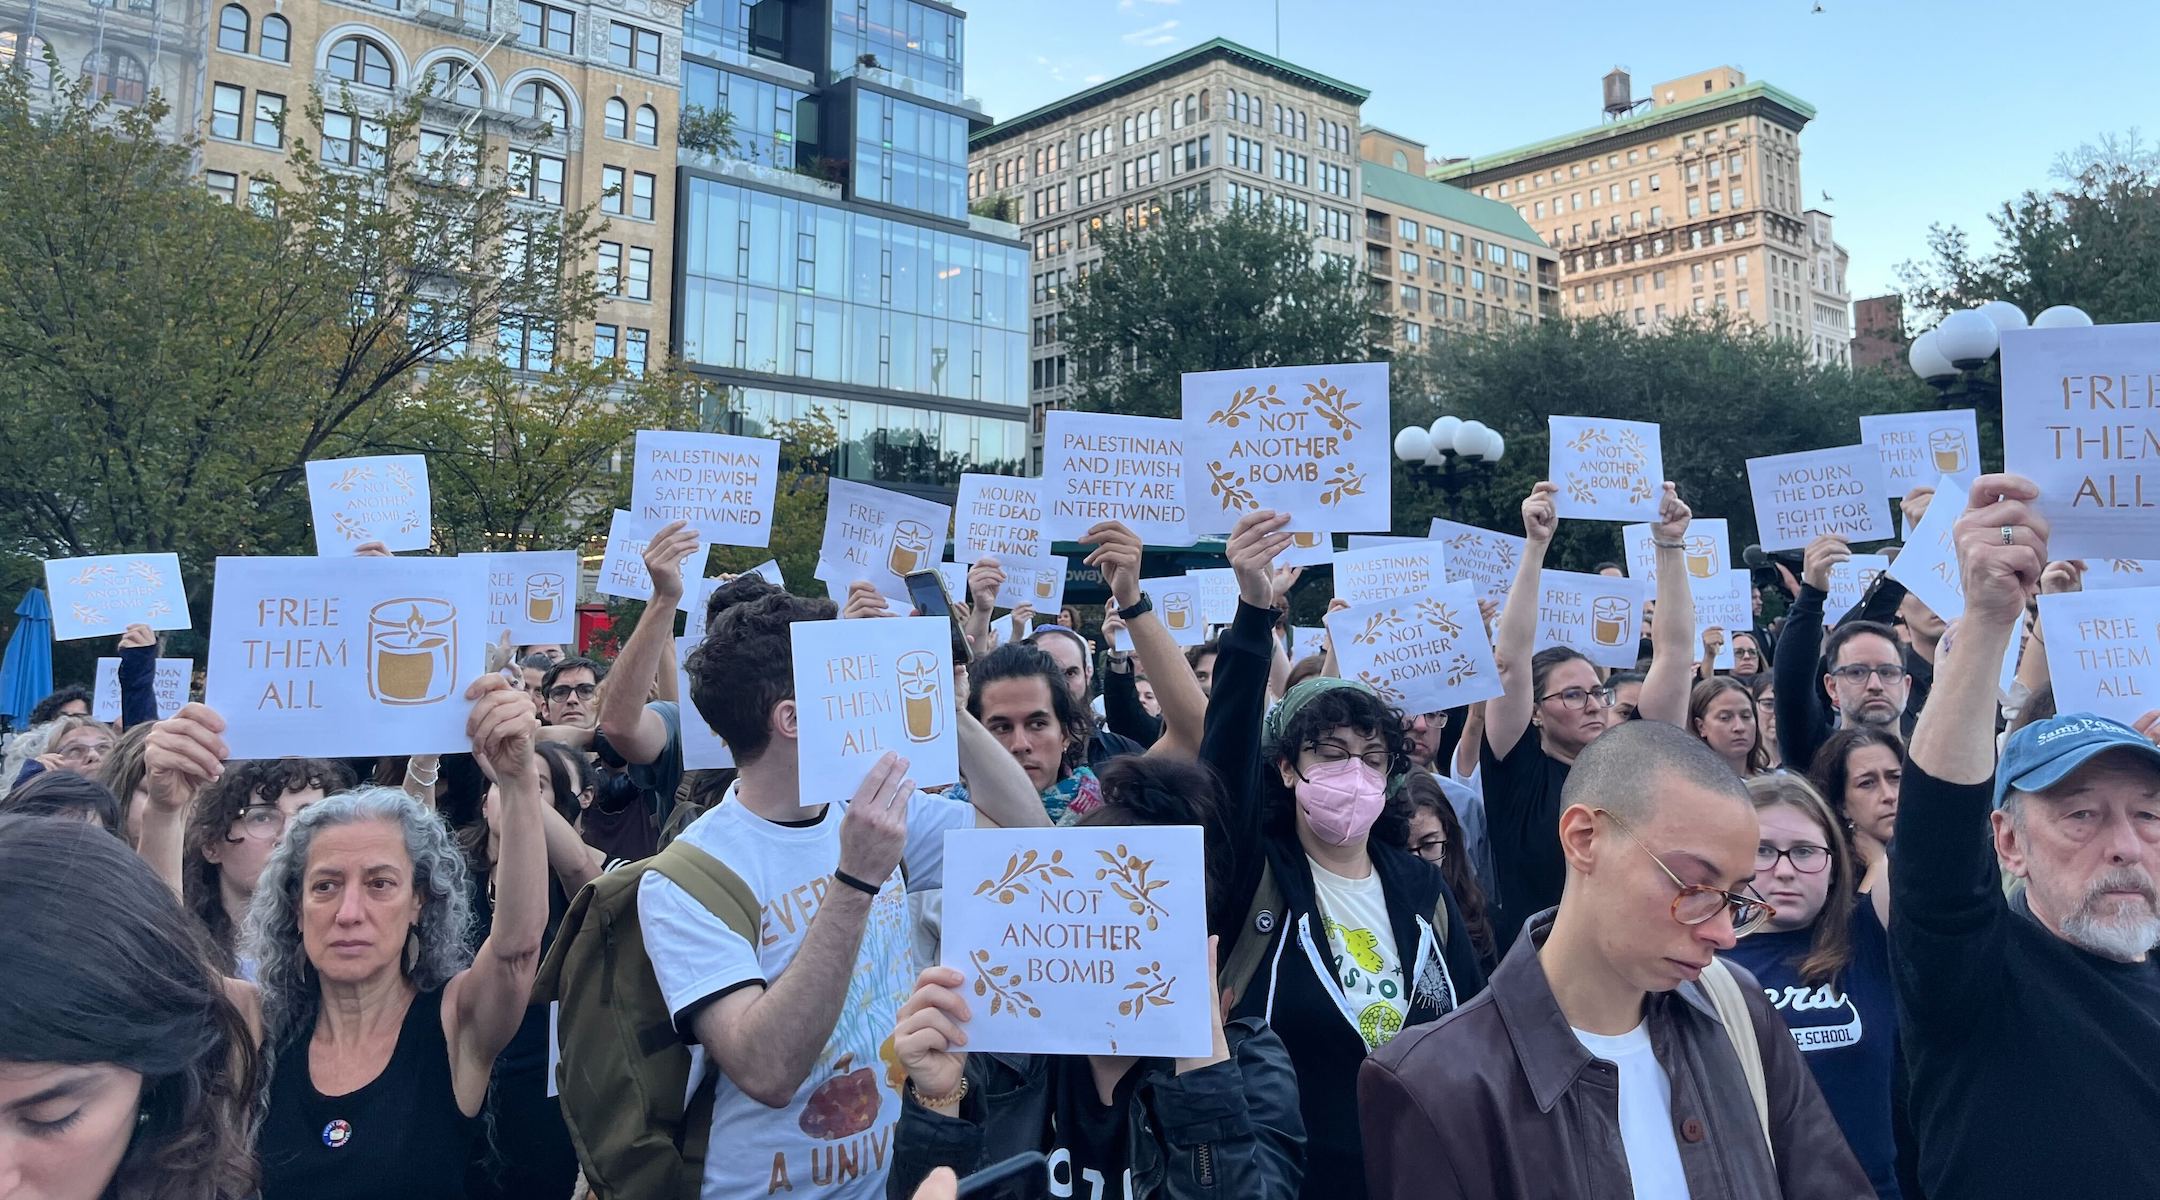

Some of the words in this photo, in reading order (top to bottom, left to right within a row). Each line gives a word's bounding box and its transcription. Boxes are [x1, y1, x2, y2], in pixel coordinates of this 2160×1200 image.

[1259, 412, 1309, 432] NOT
[1064, 433, 1183, 456] PALESTINIAN
[1881, 430, 1917, 446] FREE
[1229, 437, 1340, 459] ANOTHER
[1596, 446, 1623, 458] NOT
[1879, 447, 1924, 463] THEM
[652, 449, 760, 468] PALESTINIAN
[1063, 456, 1109, 474] AND
[1113, 459, 1180, 478] JEWISH
[1580, 461, 1639, 475] ANOTHER
[651, 468, 692, 482] AND
[697, 469, 758, 487] JEWISH
[1250, 462, 1318, 483] BOMB
[1778, 464, 1852, 486] MOURN
[1889, 464, 1917, 479] ALL
[363, 482, 390, 493] NOT
[1067, 478, 1136, 497] SAFETY
[1140, 483, 1175, 500] ARE
[1591, 476, 1629, 489] BOMB
[1771, 488, 1805, 504] THE
[1811, 480, 1864, 499] DEAD
[2072, 474, 2155, 508] ALL
[347, 495, 408, 510] ANOTHER
[655, 487, 717, 502] SAFETY
[721, 490, 753, 505] ARE
[980, 487, 1037, 505] MOURN
[362, 511, 400, 523] BOMB
[644, 505, 761, 525] INTERTWINED
[849, 503, 886, 526] FREE
[971, 502, 996, 517] THE
[998, 504, 1041, 522] DEAD
[1054, 500, 1185, 522] INTERTWINED
[1777, 507, 1826, 526] FIGHT
[1833, 502, 1868, 519] FOR
[841, 522, 885, 548] THEM
[969, 522, 1006, 538] FIGHT
[1009, 527, 1038, 542] FOR
[1777, 525, 1811, 541] THE
[1815, 518, 1873, 537] LIVING
[967, 537, 986, 551] THE
[989, 541, 1038, 558] LIVING
[1640, 537, 1656, 550] FR
[844, 547, 869, 567] ALL
[1468, 548, 1493, 560] NOT
[1636, 554, 1655, 567] TH
[615, 559, 648, 576] FIGH
[1346, 556, 1429, 573] PALESTINIAN
[1451, 555, 1504, 575] ANOTHER
[1830, 568, 1850, 579] REE
[104, 575, 134, 586] NOT
[489, 572, 514, 587] REE
[610, 572, 637, 588] THE
[1007, 574, 1031, 586] HEM
[1348, 573, 1378, 586] AND
[1382, 570, 1430, 586] JEWISH
[1457, 568, 1491, 584] BOMB
[86, 586, 154, 600] ANOTHER
[1006, 586, 1023, 597] ALL
[1352, 586, 1399, 600] SAFETY
[1830, 583, 1855, 593] HEM
[102, 599, 144, 609] BOMB
[1546, 589, 1582, 607] FREE
[1828, 596, 1850, 608] ALL
[258, 597, 340, 627] FREE
[489, 610, 507, 624] LL
[1539, 607, 1585, 626] THEM
[1719, 603, 1742, 613] FOR
[1707, 613, 1744, 624] LIVING
[1389, 624, 1424, 643] NOT
[1545, 628, 1574, 644] ALL
[2078, 617, 2139, 641] FREE
[242, 638, 348, 669] THEM
[1373, 638, 1452, 667] ANOTHER
[2073, 645, 2152, 671] THEM
[827, 654, 881, 684] FREE
[1390, 659, 1441, 682] BOMB
[258, 680, 322, 710] ALL
[2096, 675, 2142, 699] ALL
[821, 689, 892, 721] THEM
[841, 726, 884, 757] ALL
[1040, 889, 1103, 914] NOT
[1000, 923, 1142, 950] ANOTHER
[1027, 958, 1115, 984] BOMB
[1805, 1028, 1854, 1045] SCHOOL
[768, 1151, 793, 1195] A
